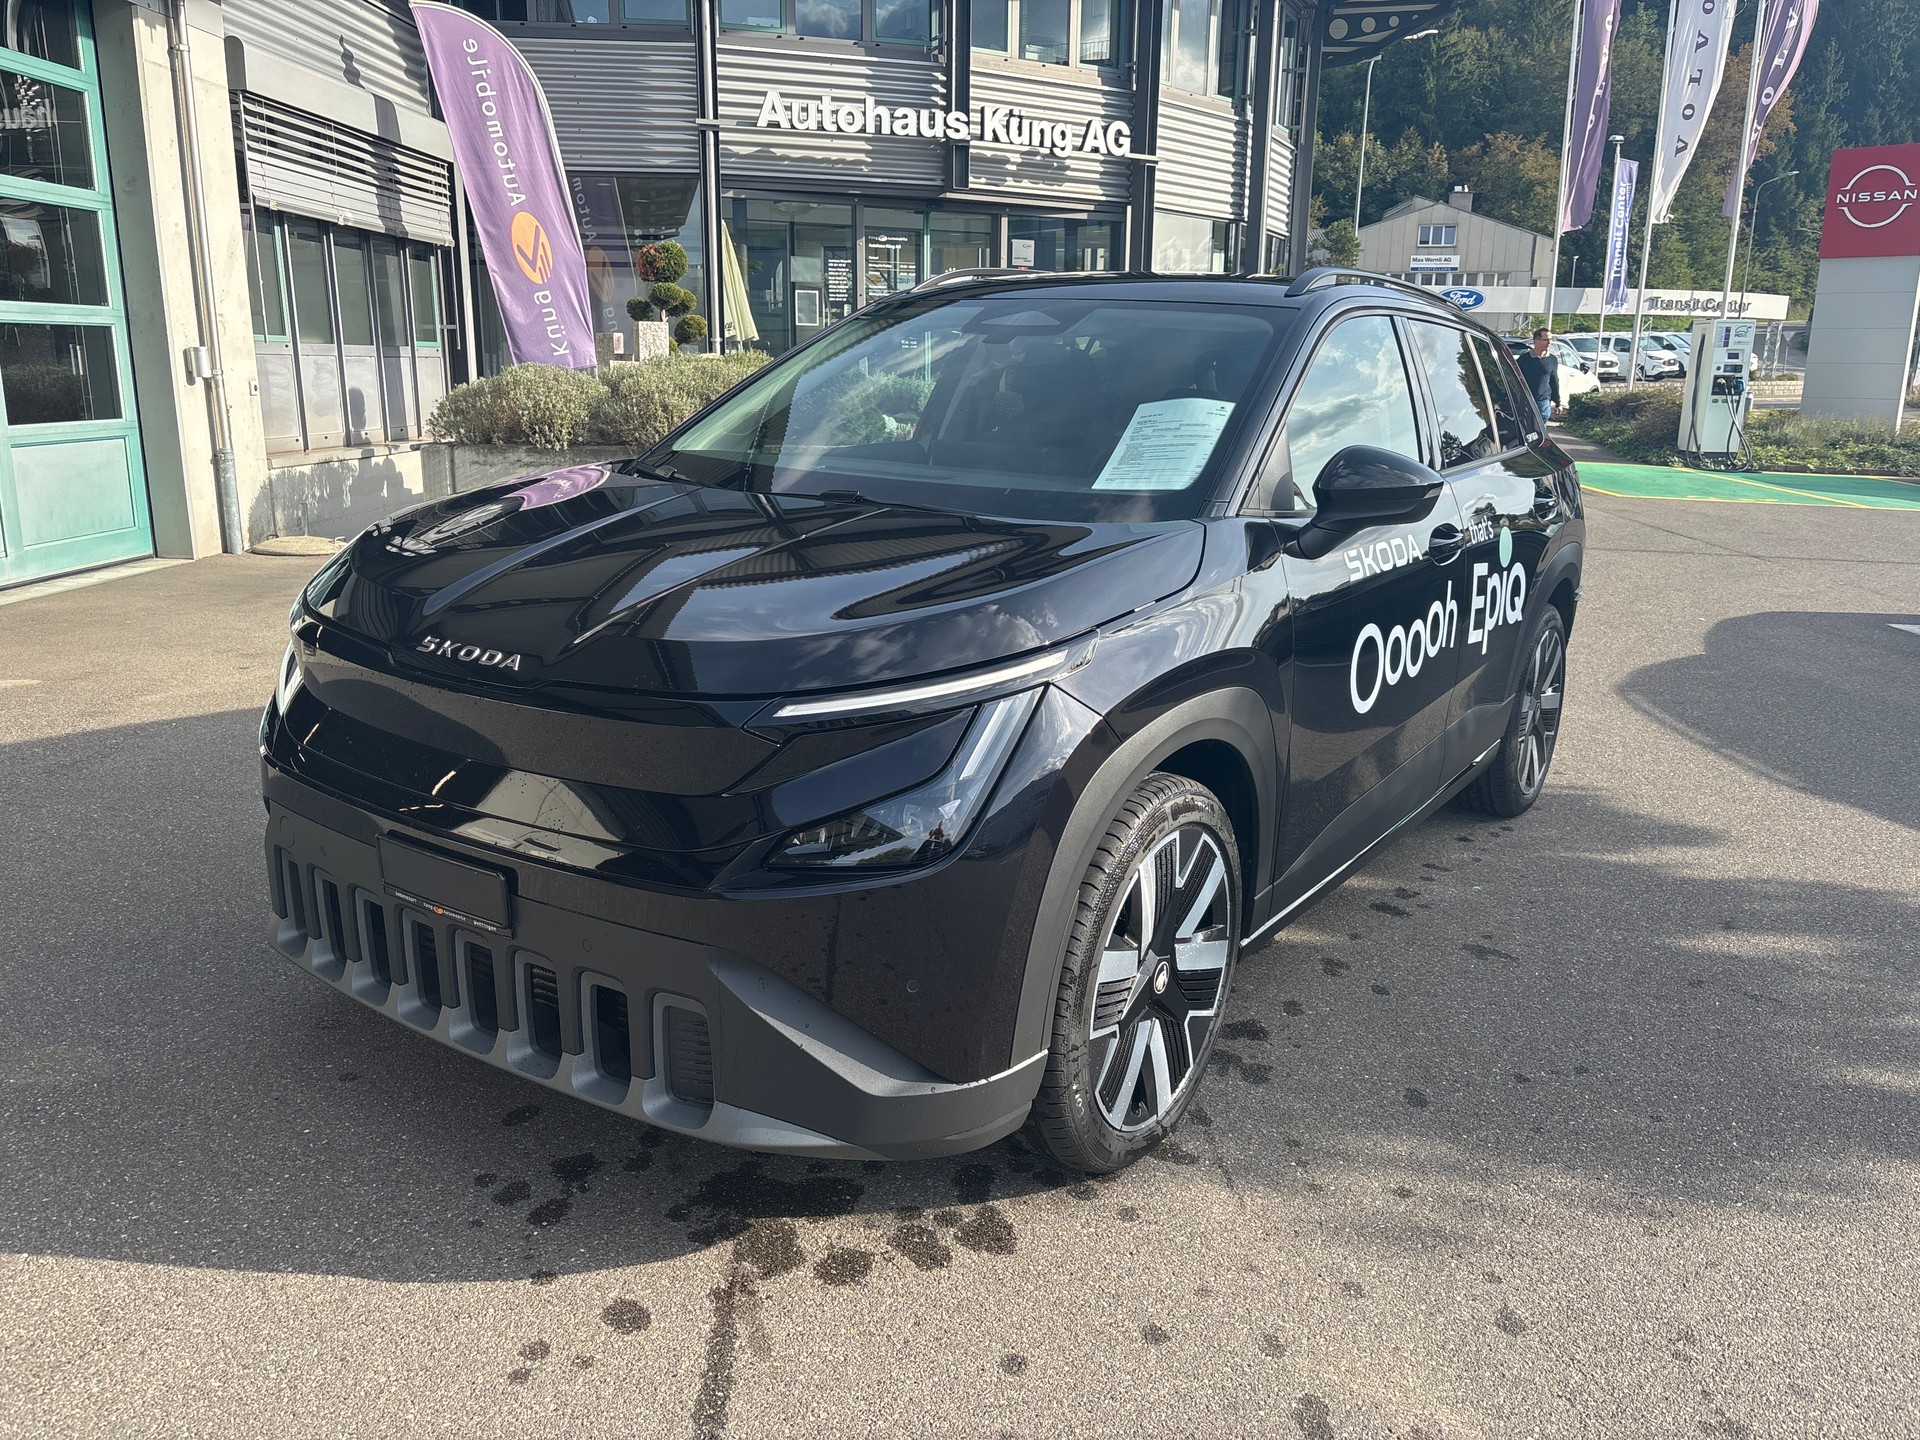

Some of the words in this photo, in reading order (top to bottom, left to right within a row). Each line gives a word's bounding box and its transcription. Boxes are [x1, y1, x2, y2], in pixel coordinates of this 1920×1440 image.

[1674, 0, 1716, 157] VOLVO
[1750, 7, 1799, 145] VOLV
[755, 90, 970, 141] Autohaus
[980, 105, 1073, 157] Küng
[1082, 118, 1131, 157] AG
[1615, 181, 1629, 227] Center
[1836, 189, 1918, 204] NISSAN
[1610, 229, 1624, 281] Transit
[1449, 290, 1477, 306] Ford
[1653, 296, 1702, 310] Transit
[1469, 515, 1494, 545] that's
[1350, 580, 1458, 714] Ooooh
[1467, 526, 1526, 655] EpiQ
